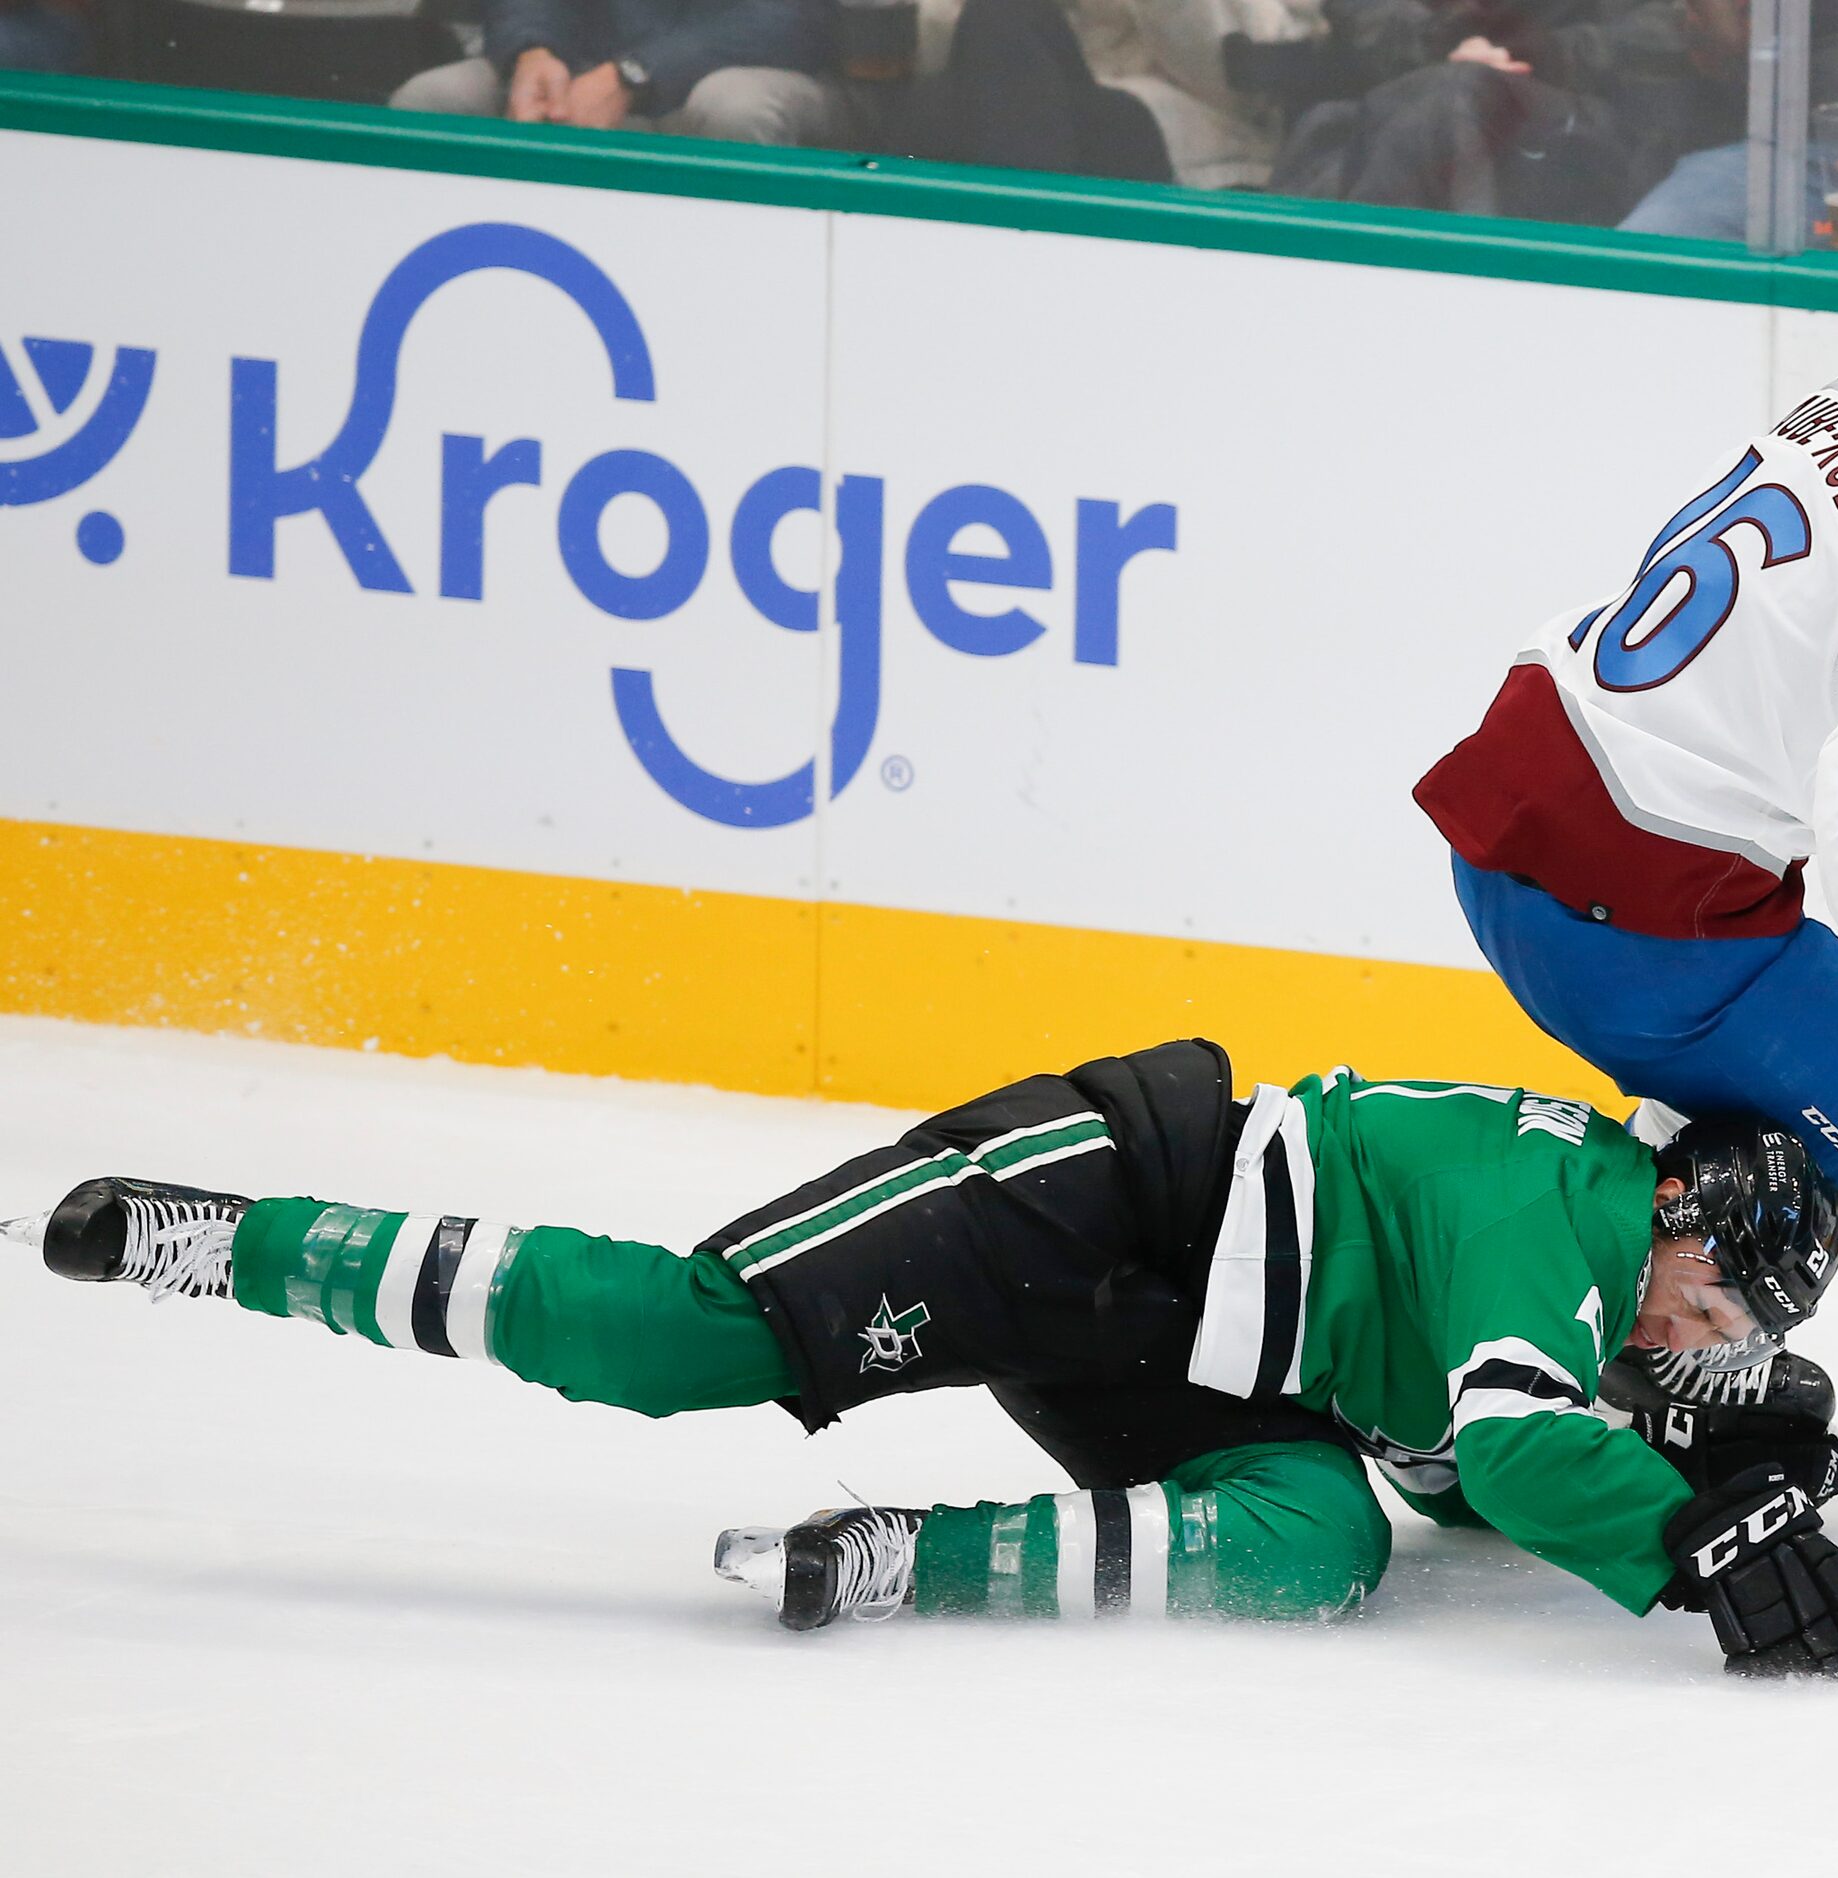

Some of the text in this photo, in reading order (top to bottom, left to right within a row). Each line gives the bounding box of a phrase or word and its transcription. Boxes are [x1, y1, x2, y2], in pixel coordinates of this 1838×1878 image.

[228, 222, 1178, 829] Kroger
[1766, 1151, 1778, 1192] TRANSFER
[1776, 1151, 1787, 1184] ENERGY
[1764, 1275, 1801, 1314] CCM
[1691, 1485, 1815, 1579] CCM
